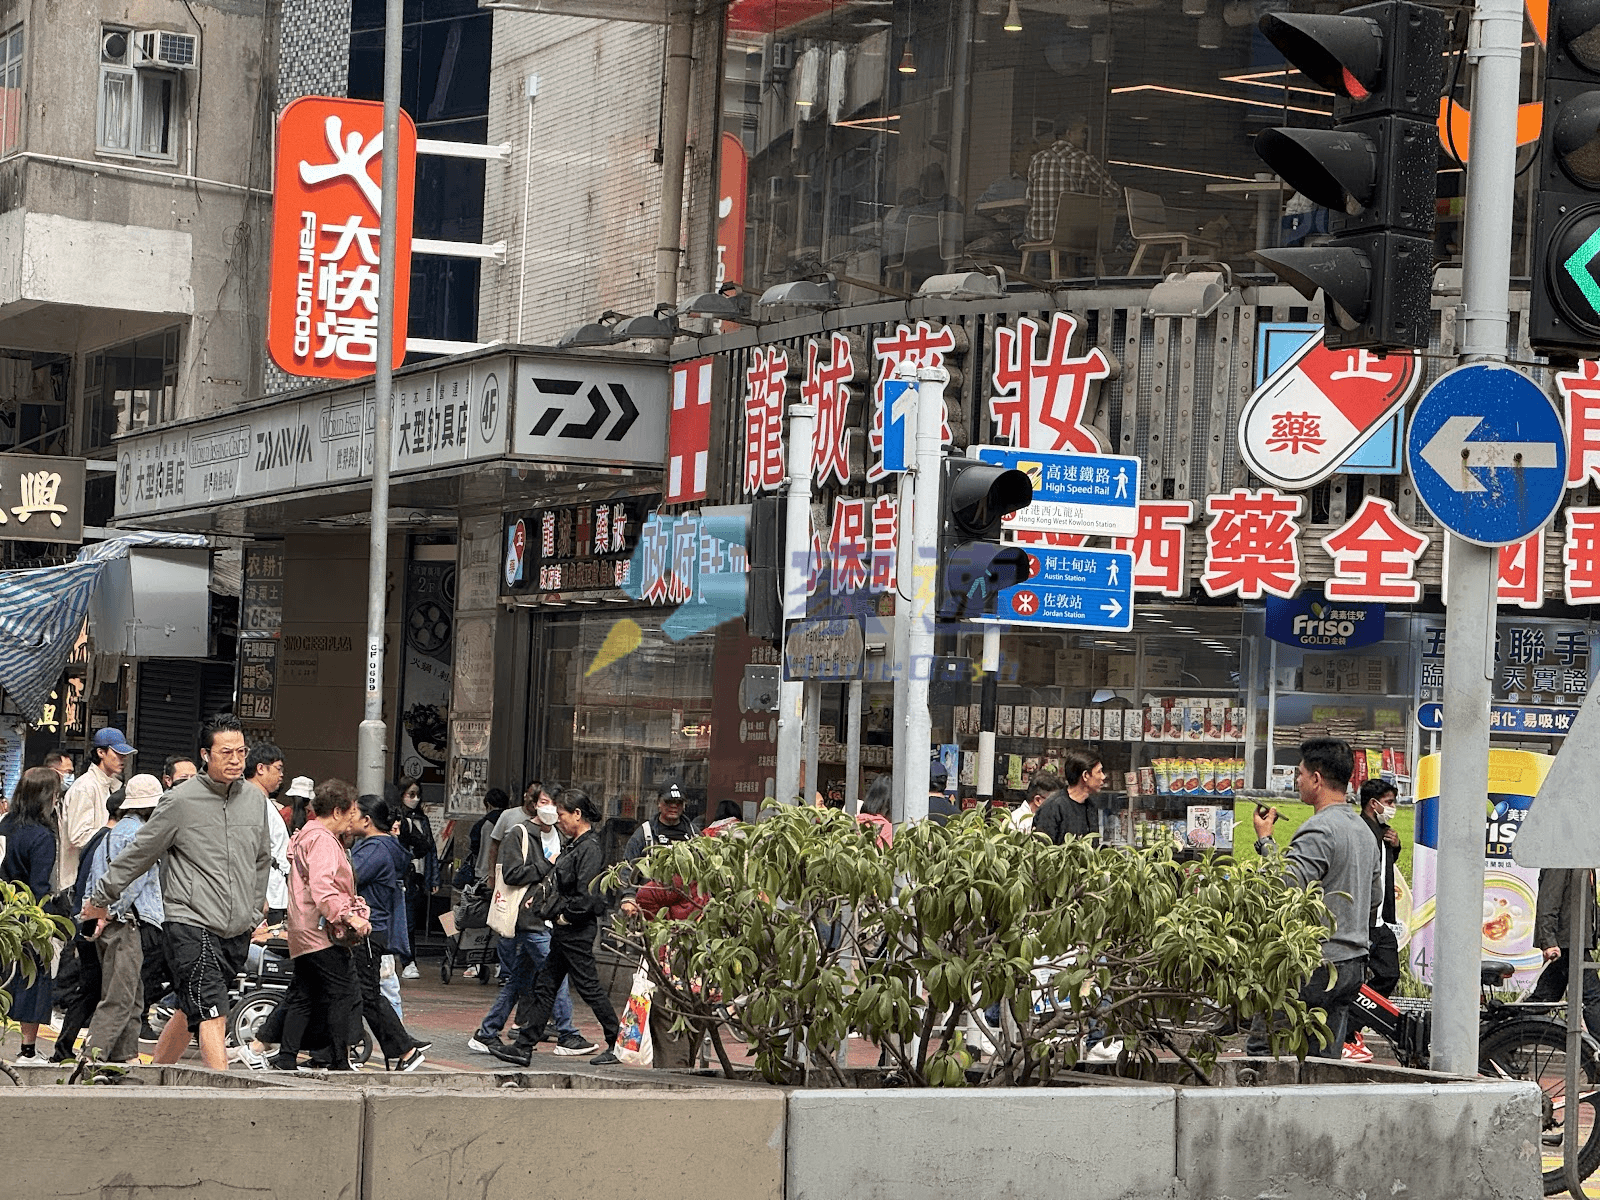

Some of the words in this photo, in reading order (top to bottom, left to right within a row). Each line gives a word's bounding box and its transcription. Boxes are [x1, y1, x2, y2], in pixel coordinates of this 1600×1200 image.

[315, 215, 381, 362] 大快活
[482, 388, 496, 430] 4F
[399, 400, 468, 457] 大型釣具店
[1265, 411, 1327, 455] 藥
[255, 424, 313, 472] DAIWA
[120, 463, 130, 495] 4F
[135, 458, 185, 501] 大型釣具店
[1046, 464, 1110, 484] 高速鐵路
[0, 470, 68, 527] 興
[1045, 483, 1065, 493] High
[1067, 485, 1093, 495] Speed
[1094, 485, 1110, 496] Rail
[1020, 504, 1084, 519] 香港西九龍站
[594, 502, 627, 555] 藥妝
[1019, 516, 1035, 524] Hong
[1036, 517, 1052, 525] Kong
[1069, 519, 1094, 527] Kowloon
[1096, 520, 1117, 528] Station
[1045, 556, 1097, 574] 柯士甸站
[418, 577, 436, 593] 2F
[1065, 574, 1086, 582] Station
[1043, 593, 1083, 610] 佐敦站
[1064, 611, 1086, 619] Station
[1293, 615, 1354, 637] Friso
[284, 636, 302, 651] SINO
[329, 636, 353, 652] PLAZA
[1300, 636, 1331, 645] GOLD
[1422, 627, 1589, 666] 五聯手
[1422, 663, 1587, 693] 臨天實證
[1434, 708, 1443, 723] N
[1523, 713, 1571, 730] 易吸收
[1414, 947, 1429, 976] 4
[1356, 992, 1378, 1010] TOP
